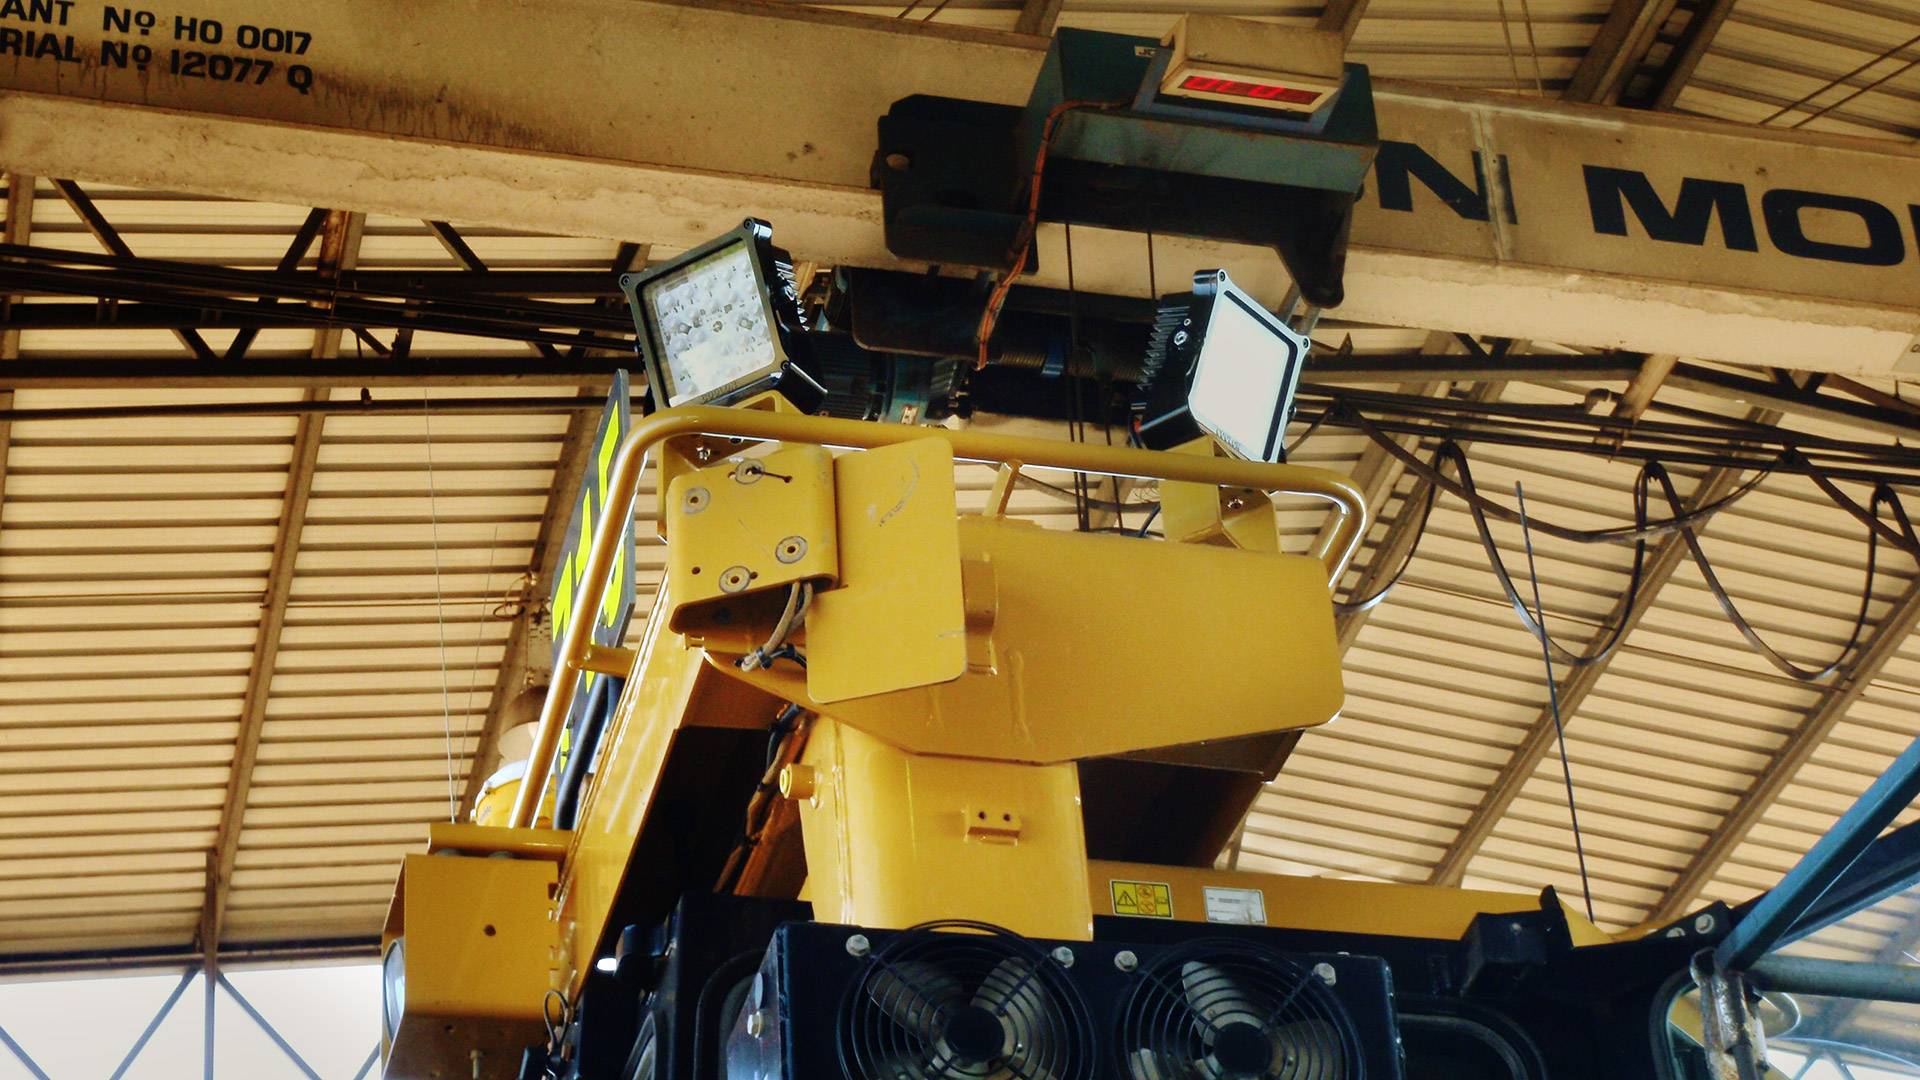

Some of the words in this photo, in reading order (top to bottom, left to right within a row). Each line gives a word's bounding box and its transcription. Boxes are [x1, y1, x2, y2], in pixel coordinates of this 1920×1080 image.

[236, 25, 312, 55] 0017
[170, 49, 274, 85] 12077
[287, 64, 313, 95] Q
[1350, 139, 1518, 225] N
[1582, 164, 1920, 266] MO
